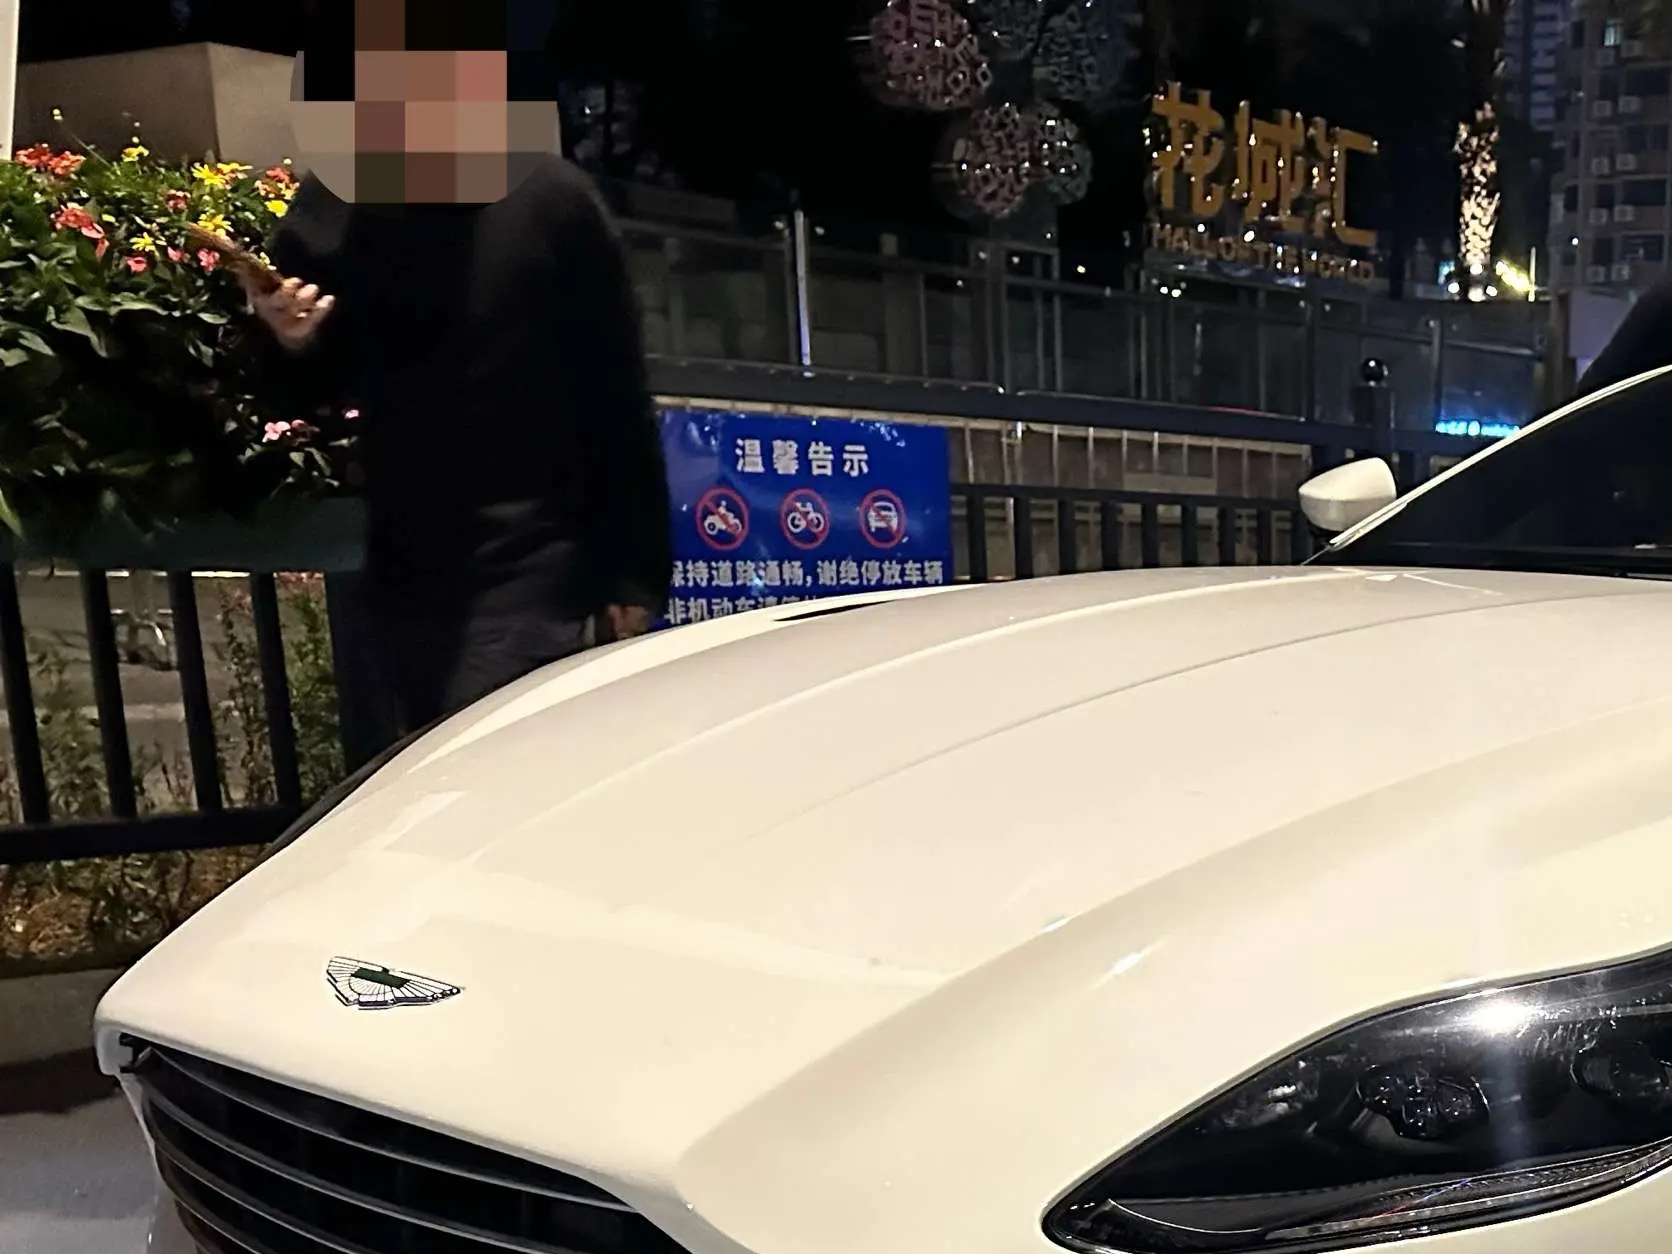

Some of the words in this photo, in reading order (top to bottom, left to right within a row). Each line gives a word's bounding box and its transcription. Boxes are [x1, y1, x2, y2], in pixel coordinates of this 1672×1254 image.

[1150, 80, 1378, 246] 花城汇
[735, 438, 870, 477] 温馨告示
